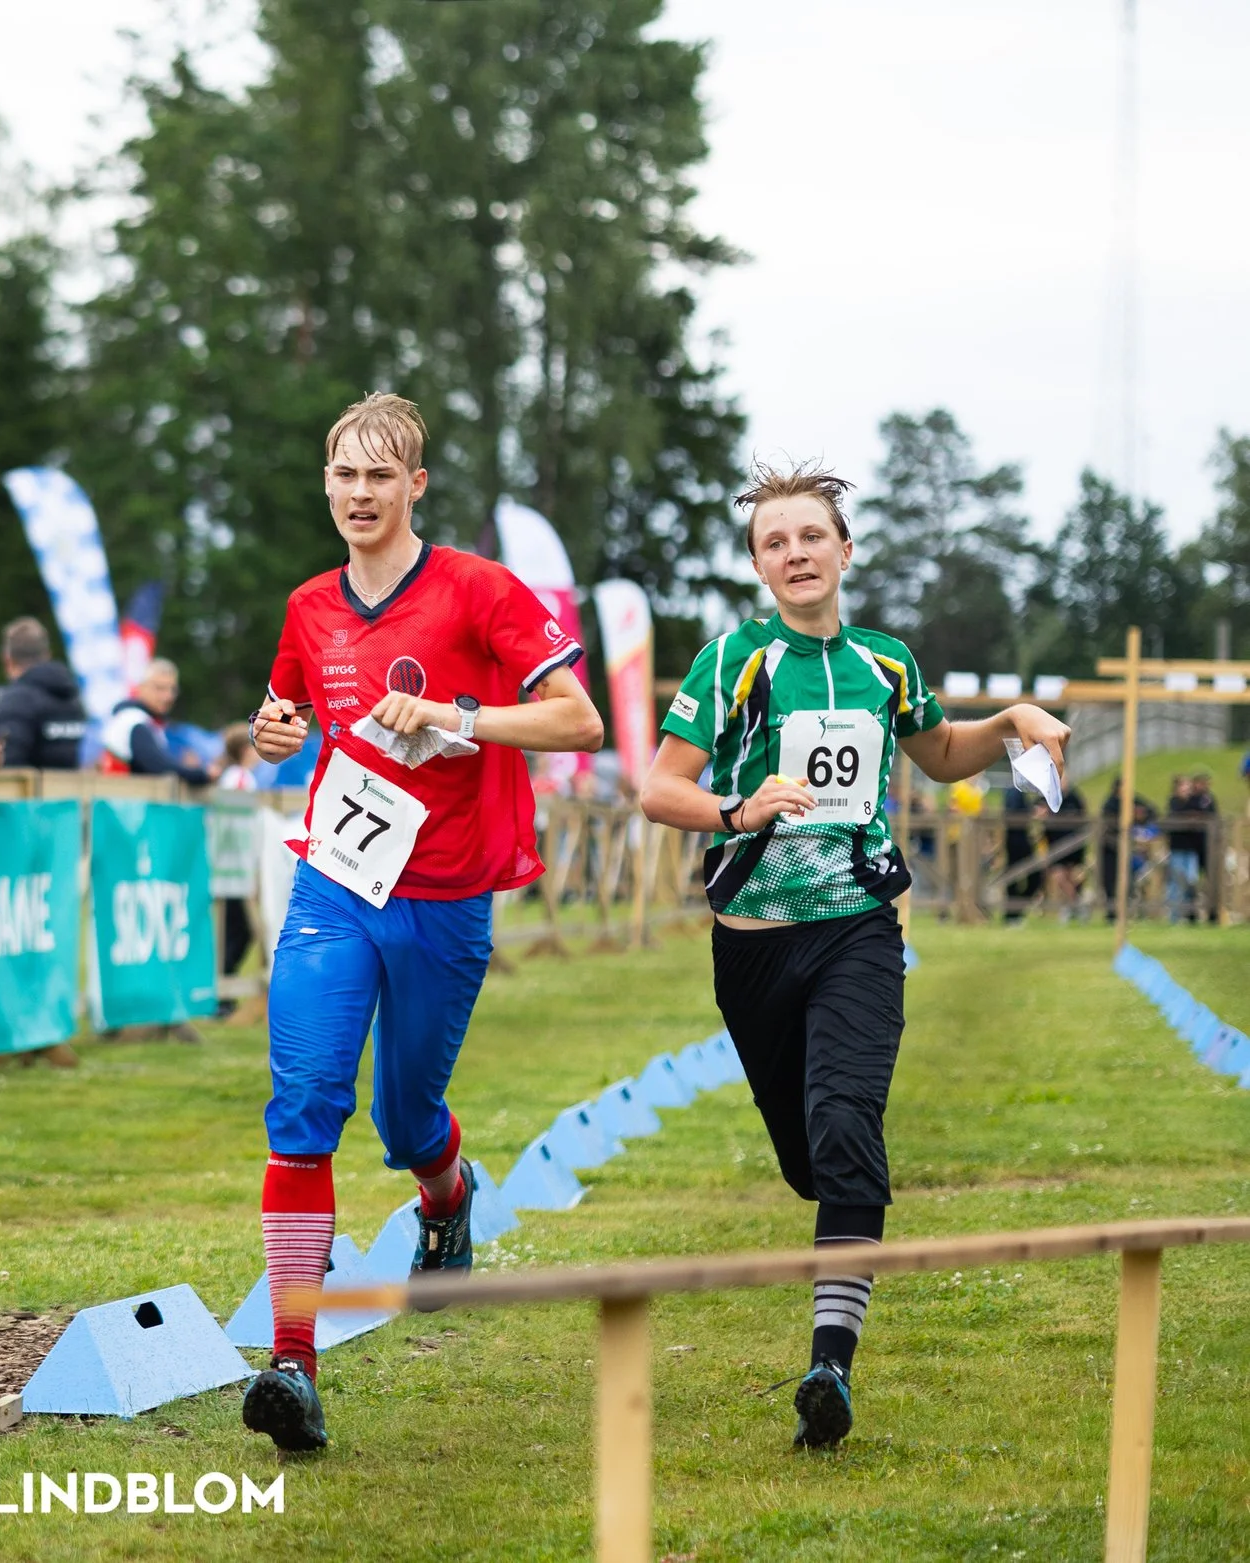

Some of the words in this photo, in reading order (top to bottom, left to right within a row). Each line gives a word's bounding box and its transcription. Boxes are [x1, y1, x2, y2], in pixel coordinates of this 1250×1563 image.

[326, 695, 360, 710] logistik
[807, 745, 860, 788] 69
[863, 801, 871, 815] 8
[334, 794, 391, 852] 77
[371, 881, 383, 896] 8
